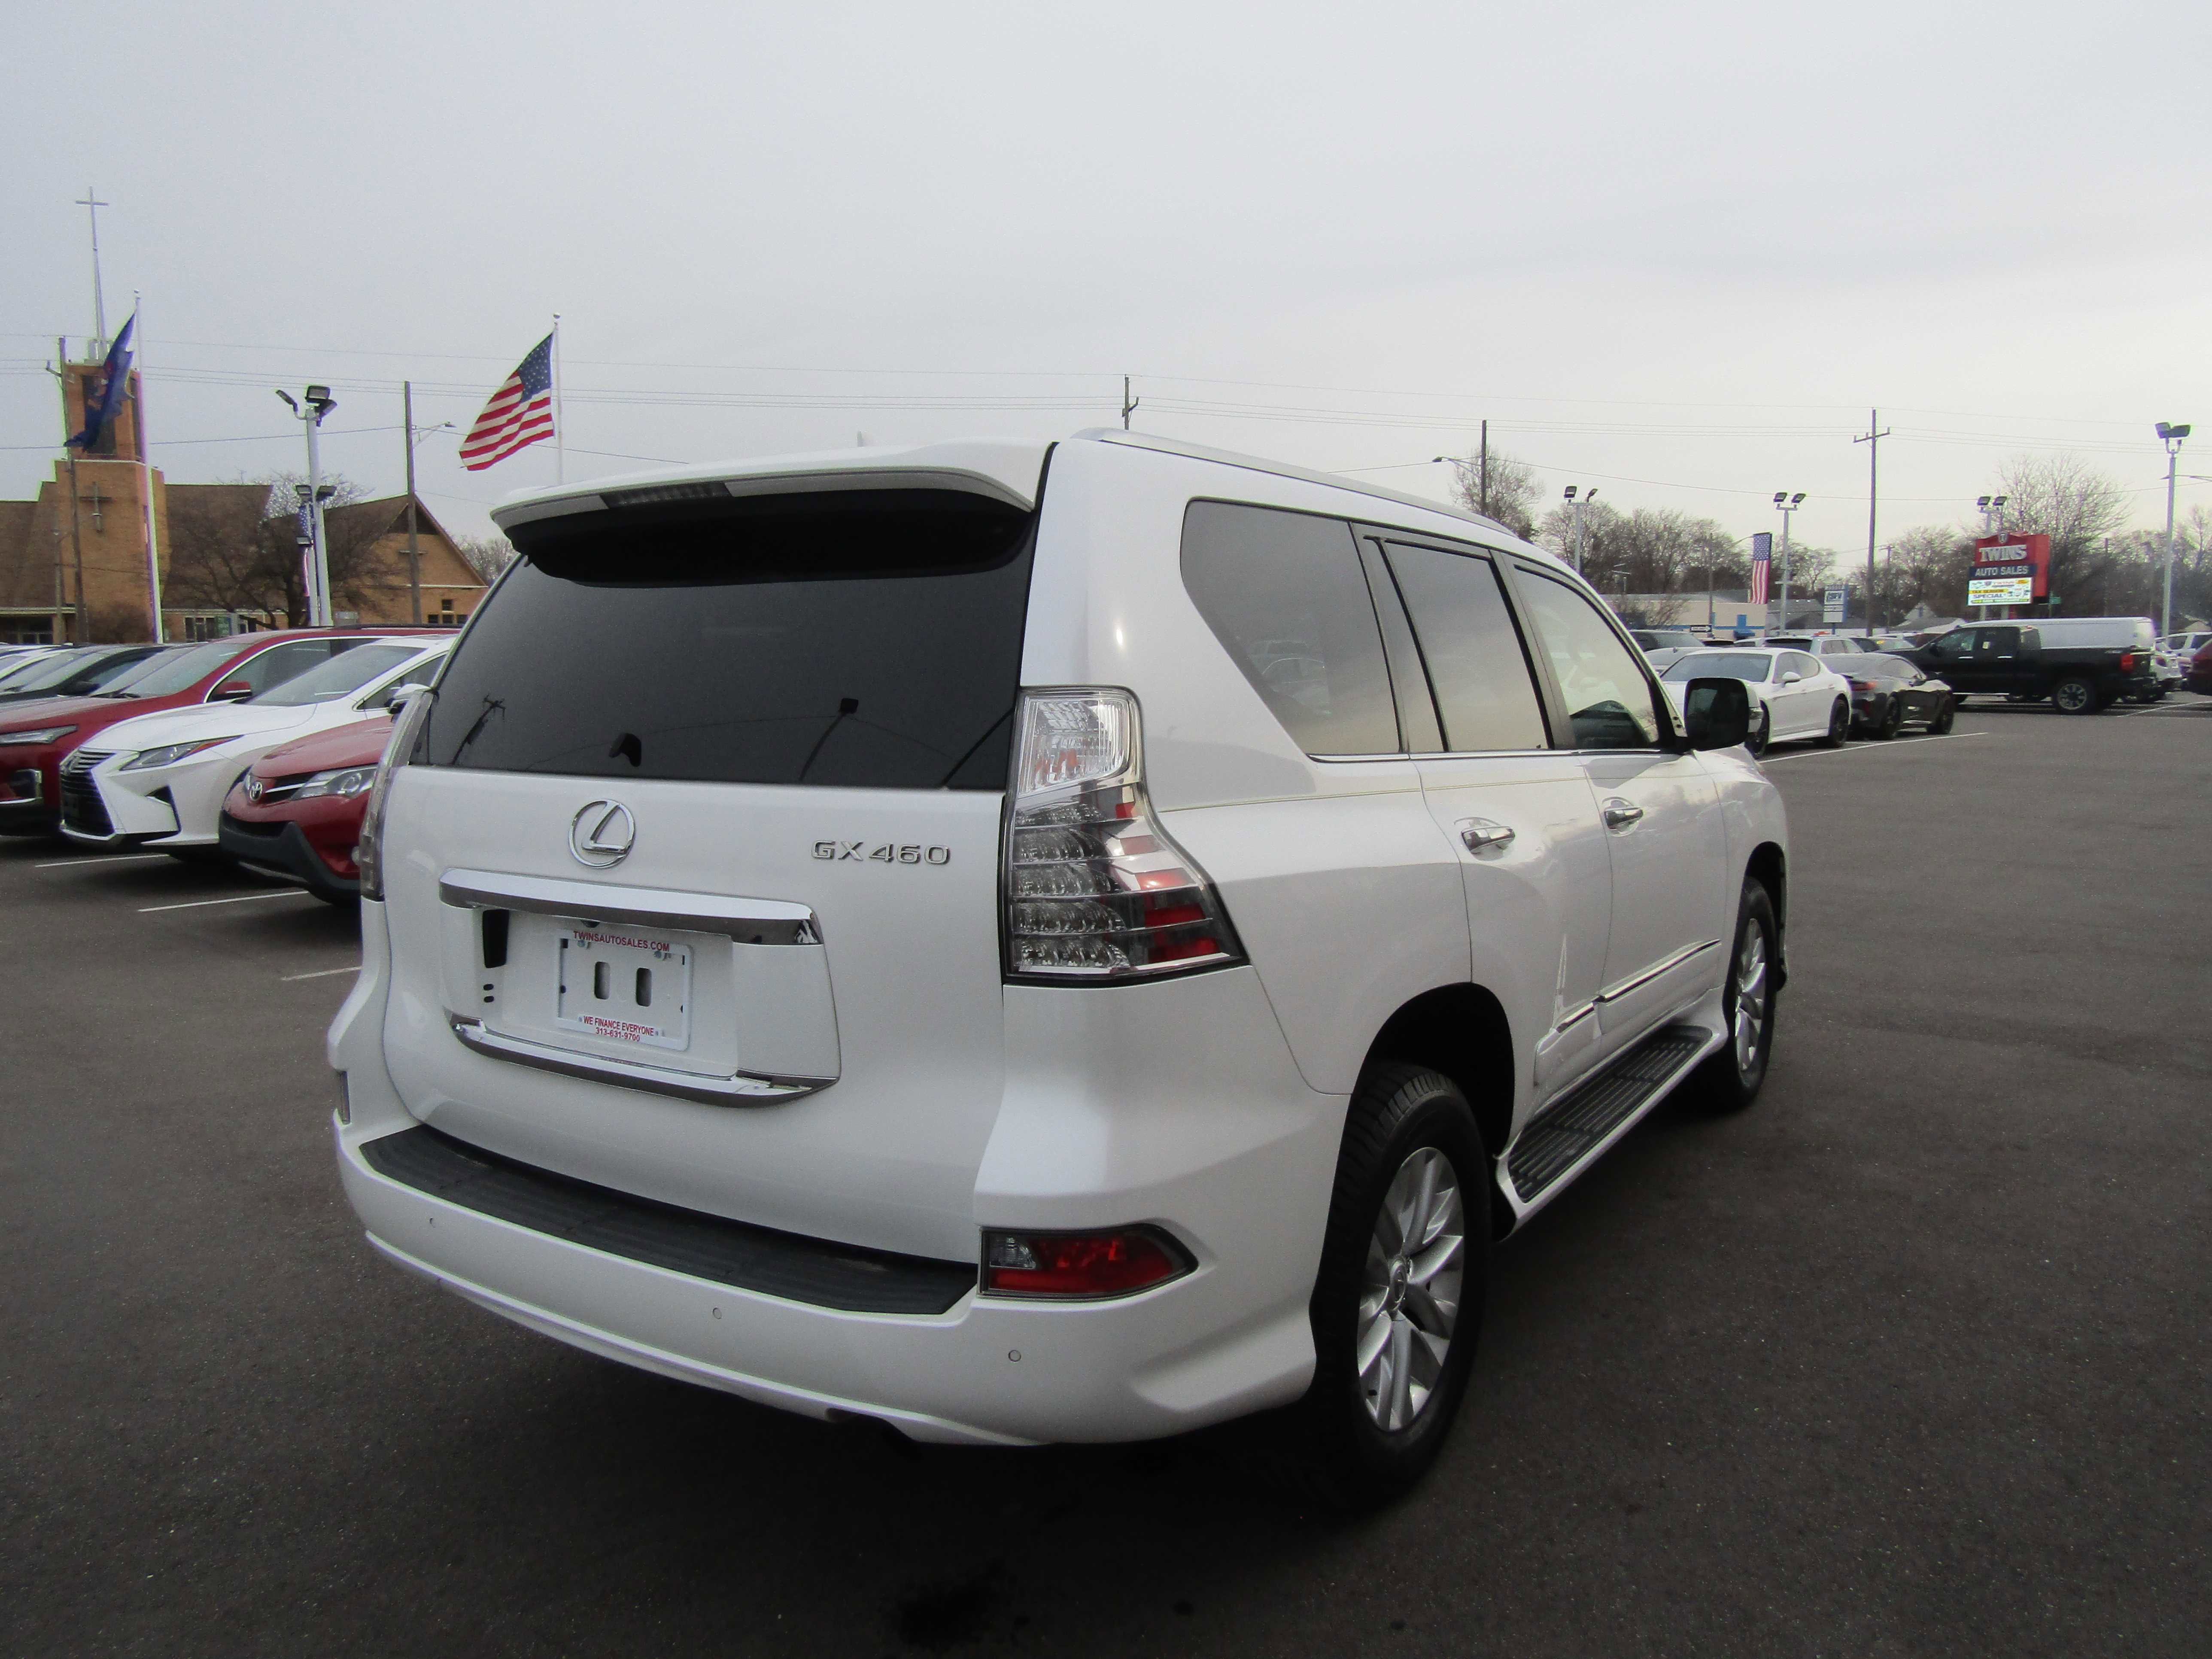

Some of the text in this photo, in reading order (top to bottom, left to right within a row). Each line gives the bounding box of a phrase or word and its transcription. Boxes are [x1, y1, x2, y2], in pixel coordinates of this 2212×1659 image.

[1979, 544, 2027, 562] TWINS
[1975, 565, 2028, 576] AUTO SALES
[573, 931, 670, 952] TWINSAUTOSALES.COM
[583, 1015, 654, 1036] WE FINANCE EVERYONE
[596, 1027, 640, 1042] 313-631-9700
